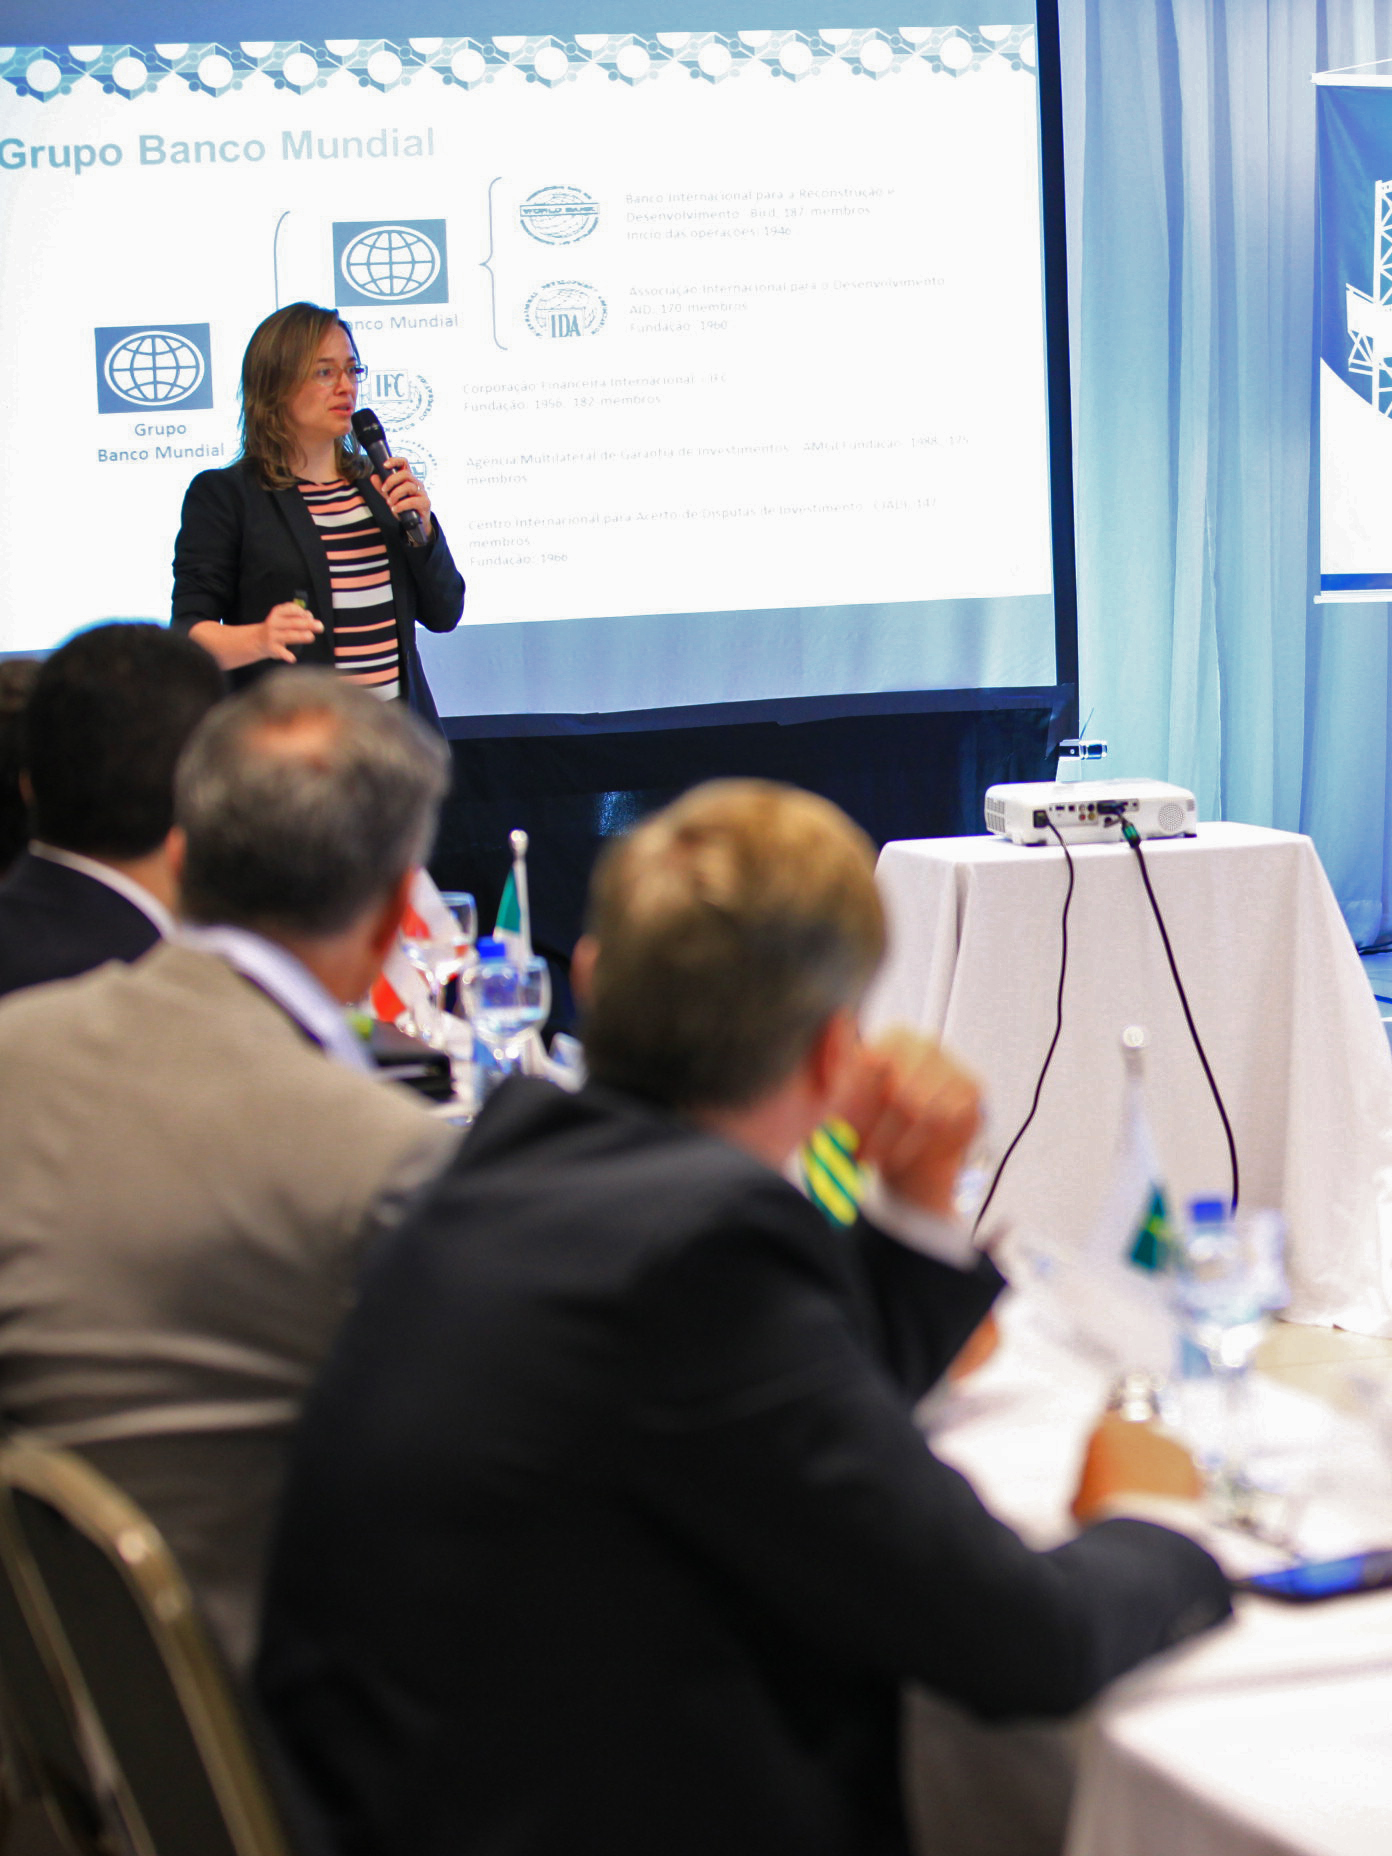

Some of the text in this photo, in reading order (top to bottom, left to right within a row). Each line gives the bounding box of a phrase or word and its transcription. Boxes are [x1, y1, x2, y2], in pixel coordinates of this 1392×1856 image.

[0, 127, 434, 175] Grupo Banco Mundial
[626, 192, 664, 204] Banco
[669, 190, 752, 202] Internacional
[756, 191, 784, 203] para
[626, 209, 740, 222] Desenvolvimento
[810, 205, 871, 216] membros
[665, 229, 687, 239] das
[629, 285, 698, 297] Associação
[702, 282, 787, 295] Internacional
[790, 281, 817, 293] para
[687, 302, 747, 313] membros
[390, 314, 459, 329] Mundial
[551, 314, 581, 338] IDA
[376, 373, 405, 398] IFC
[463, 382, 536, 396] Corporação
[540, 378, 607, 391] Financeira
[610, 375, 695, 389] Internacional
[600, 395, 662, 406] membros
[134, 423, 187, 438] Grupo
[98, 442, 225, 463] Banco Mundial
[520, 450, 596, 465] Multilateral
[600, 450, 616, 460] de
[620, 448, 674, 461] Garantia
[678, 447, 693, 457] de
[697, 443, 791, 456] Investimentos
[466, 473, 528, 485] membros
[468, 518, 511, 530] Centro
[515, 513, 600, 528] Internacional
[603, 513, 631, 526] para
[636, 509, 678, 521] Acerto
[681, 508, 698, 520] de
[779, 501, 864, 514] Investimento
[468, 536, 530, 548] membros
